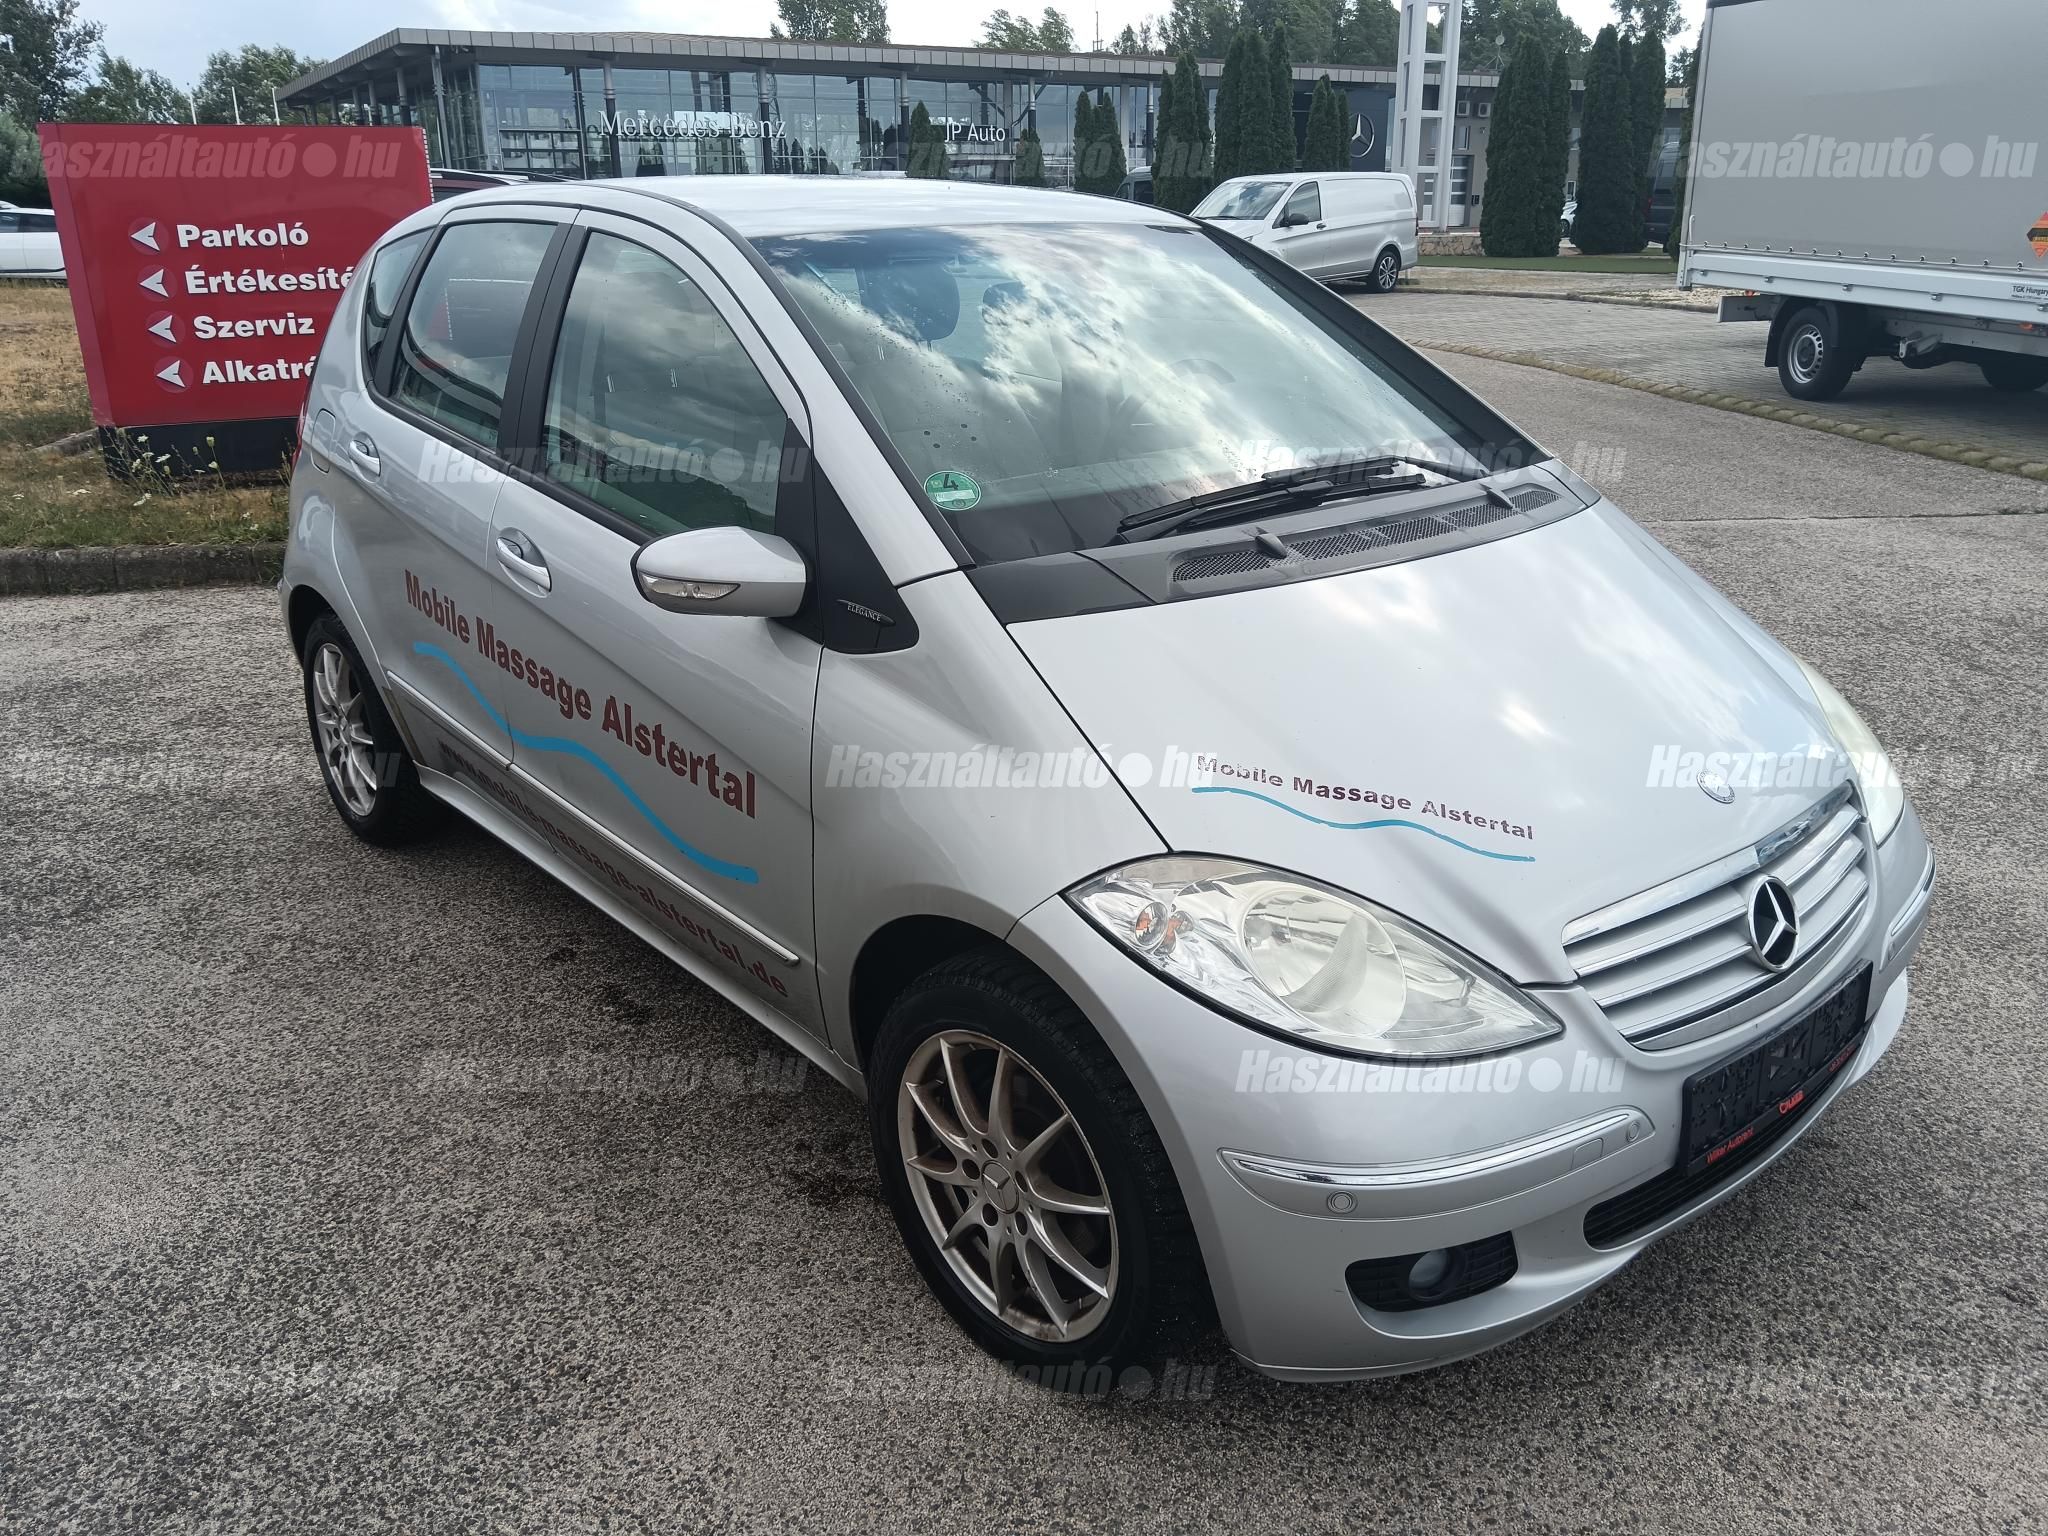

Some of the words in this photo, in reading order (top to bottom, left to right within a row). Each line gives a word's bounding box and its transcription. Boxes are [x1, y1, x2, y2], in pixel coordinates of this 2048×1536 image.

[944, 121, 962, 143] JP
[967, 122, 1006, 142] Auto
[176, 222, 309, 248] Parkoló
[193, 312, 316, 340] Szerviz
[847, 603, 881, 622] ELEGANCE
[404, 568, 471, 644] Mobile
[475, 615, 592, 721] Massage
[601, 695, 756, 820] Alstertal
[1196, 754, 1285, 787] Mobile
[1292, 776, 1413, 811] Massage
[1420, 799, 1534, 840] Alstertal
